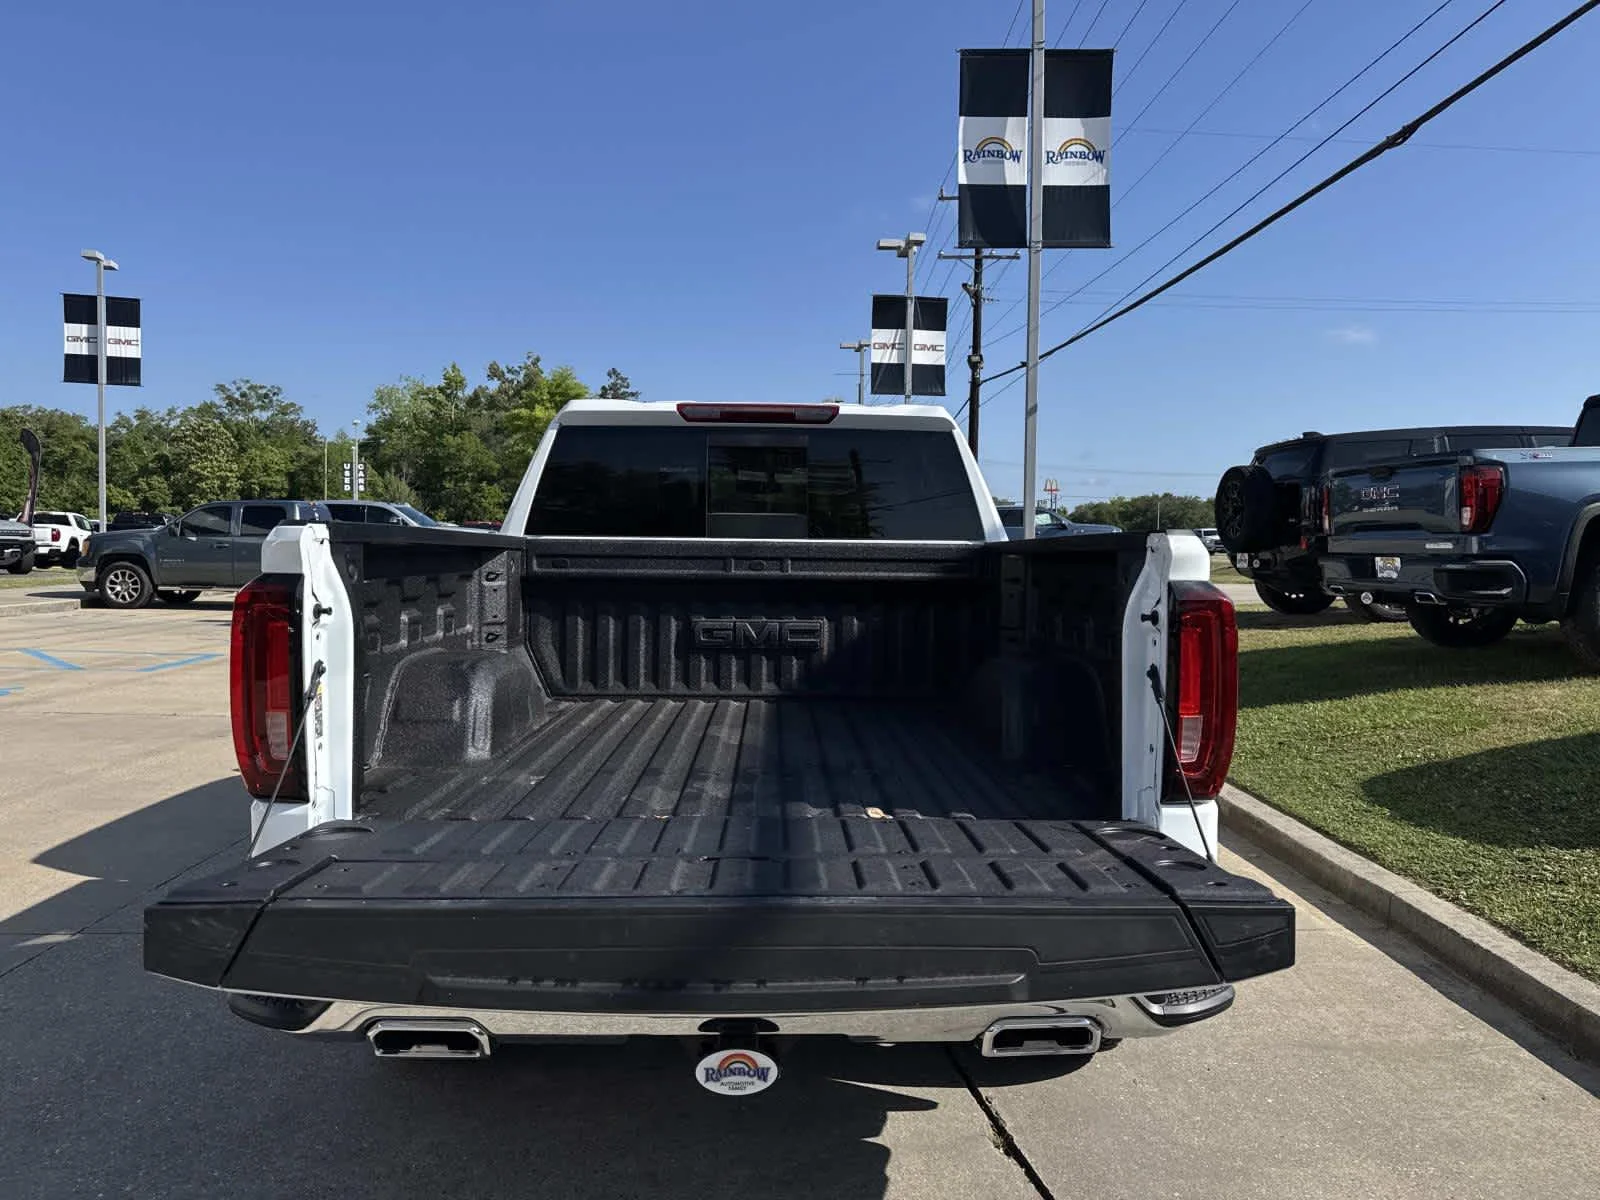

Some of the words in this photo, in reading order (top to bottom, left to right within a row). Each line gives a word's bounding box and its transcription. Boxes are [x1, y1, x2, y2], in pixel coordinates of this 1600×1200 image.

[963, 149, 1023, 164] RAINBOW
[1045, 150, 1106, 165] RAINBOW
[108, 338, 139, 346] GMC
[873, 342, 904, 350] GMC
[914, 344, 944, 352] GMC
[343, 463, 351, 491] USED
[695, 622, 821, 648] GMC
[704, 1067, 771, 1084] RAINBOW
